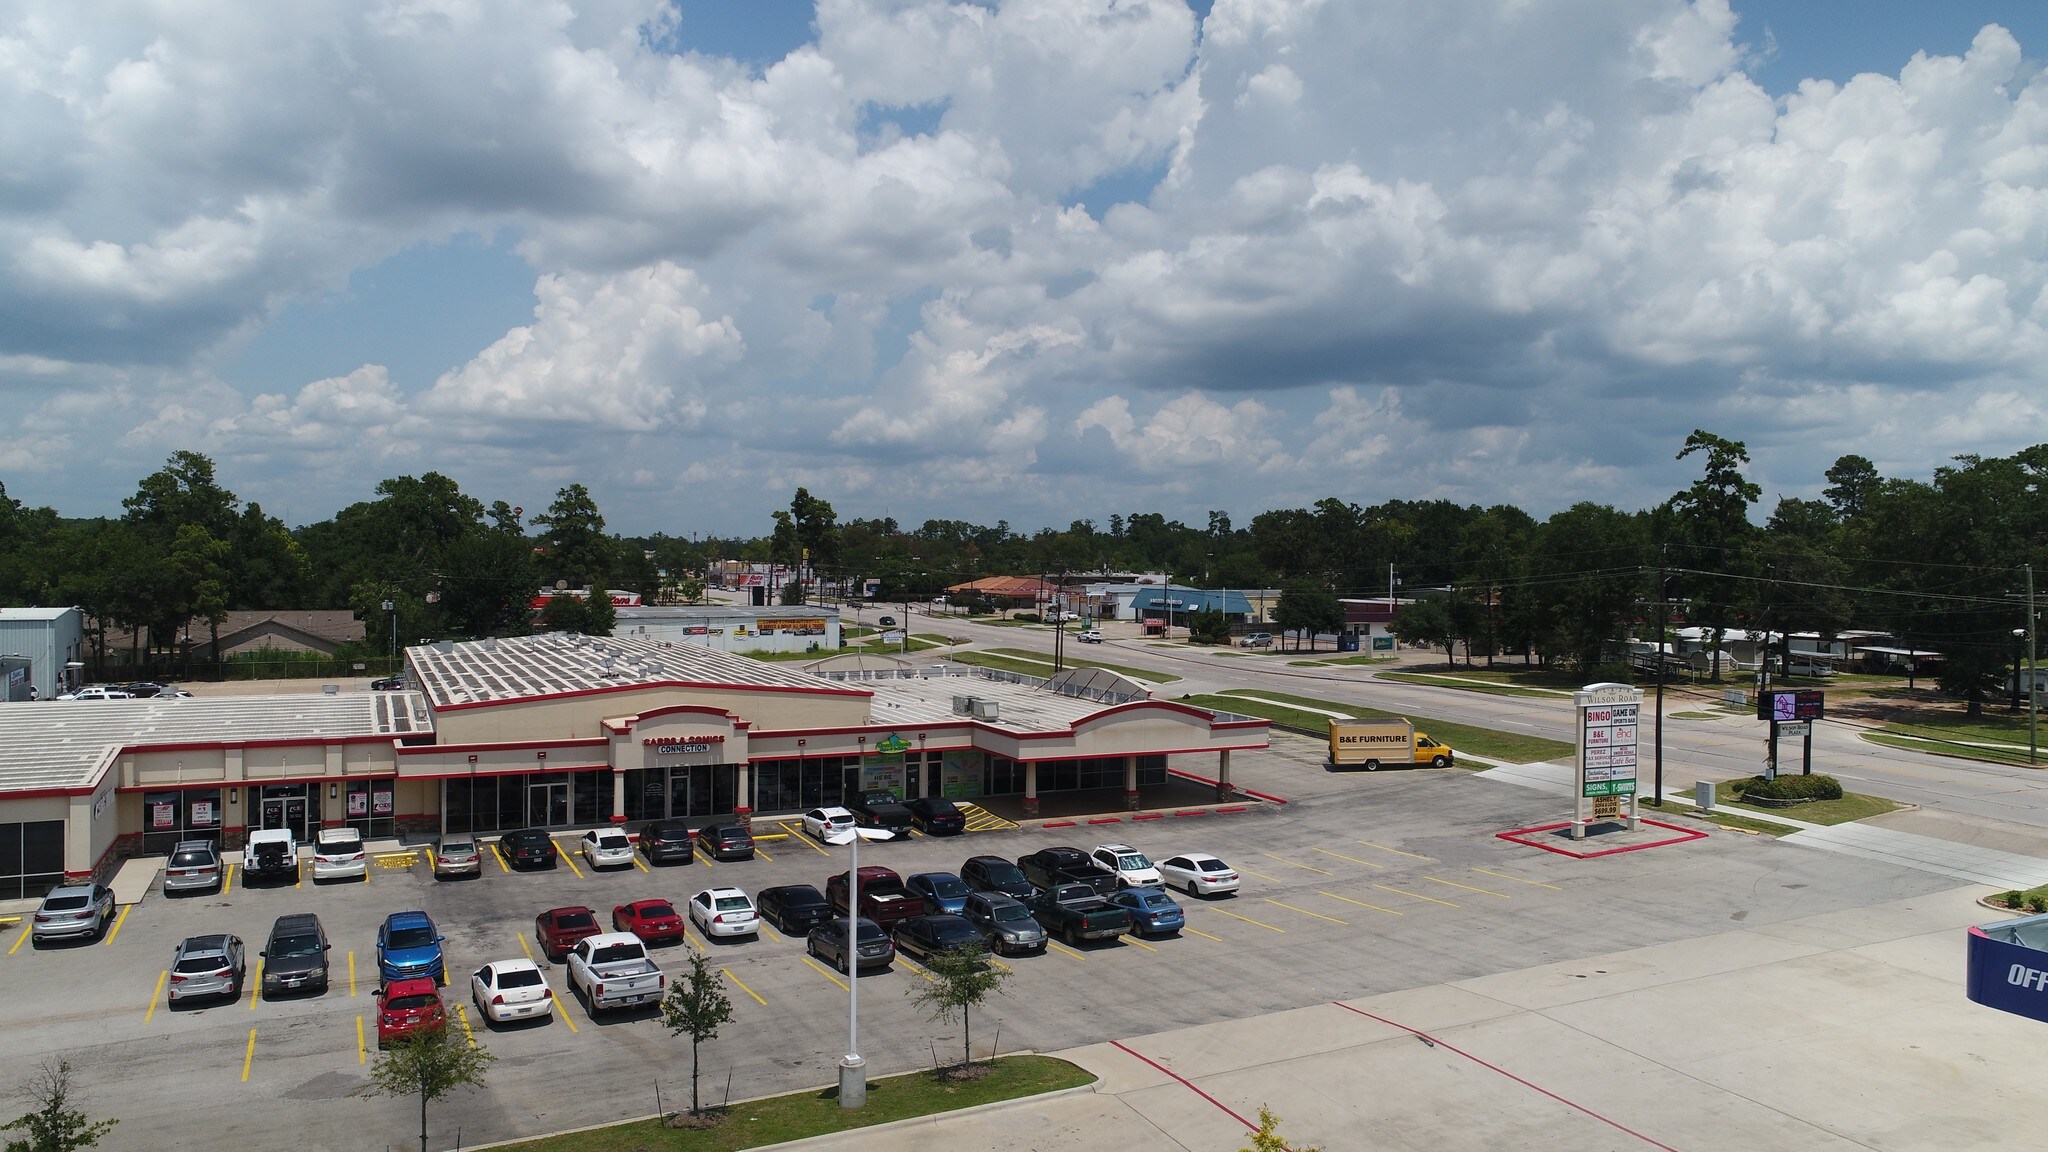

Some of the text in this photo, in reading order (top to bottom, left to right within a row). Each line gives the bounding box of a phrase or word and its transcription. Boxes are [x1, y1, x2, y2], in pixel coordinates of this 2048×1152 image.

[1587, 711, 1611, 722] BINGO
[1613, 708, 1637, 717] GAME ON
[1359, 735, 1407, 743] FURNITURE
[660, 744, 708, 753] CONNECTION
[1612, 782, 1635, 792] T-SHIRTS
[1595, 807, 1616, 815] $699.99
